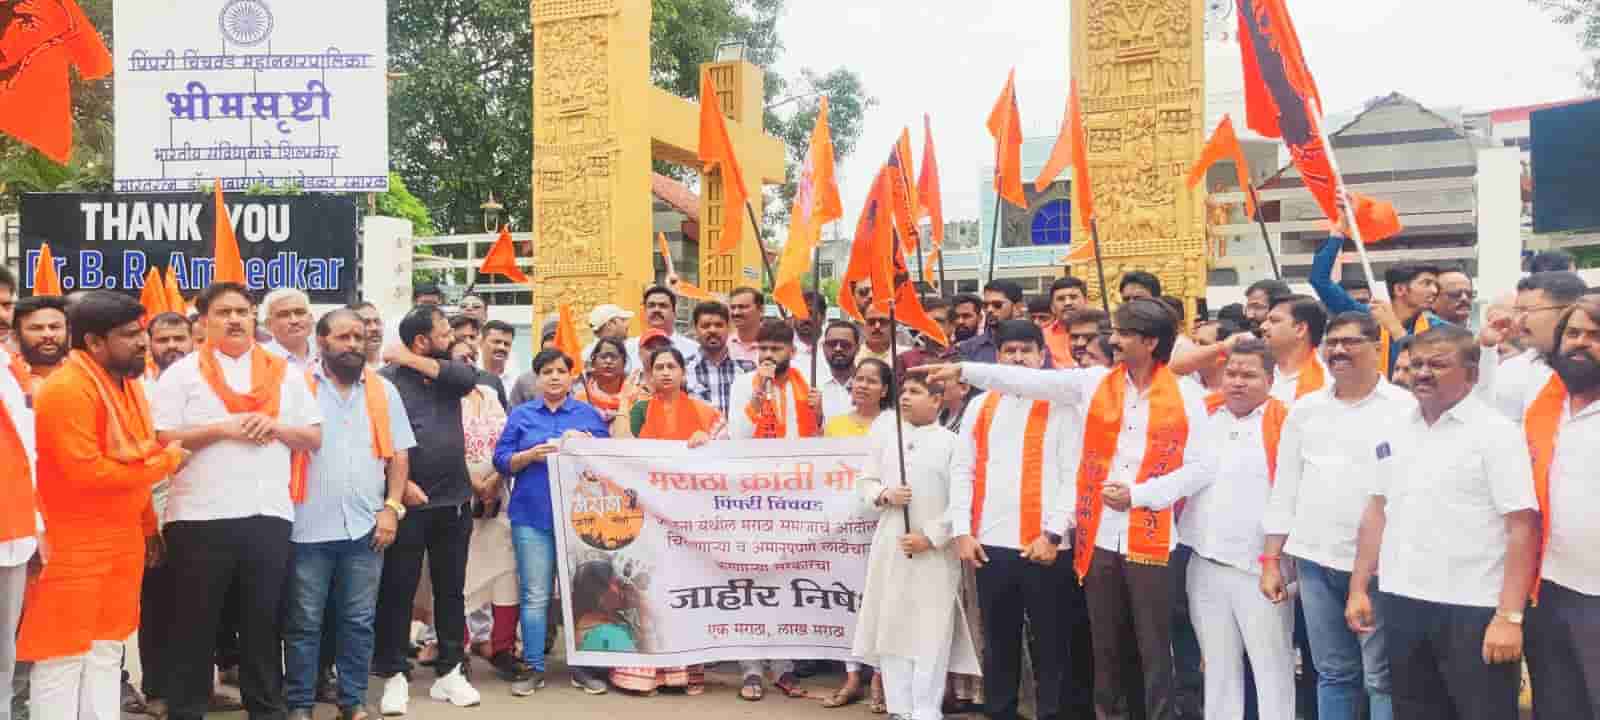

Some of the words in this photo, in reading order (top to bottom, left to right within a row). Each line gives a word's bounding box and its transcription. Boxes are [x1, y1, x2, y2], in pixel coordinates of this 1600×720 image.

[129, 49, 176, 71] पिंपरी
[242, 47, 370, 72] महानगरपालिका
[166, 80, 332, 134] भीमसृष्टी
[80, 203, 202, 241] THANK
[169, 251, 344, 289] Amedkar
[648, 471, 728, 493] मराठा
[713, 496, 761, 511] पिंपरी
[669, 579, 781, 610] जाहीर
[791, 578, 863, 612] निषे
